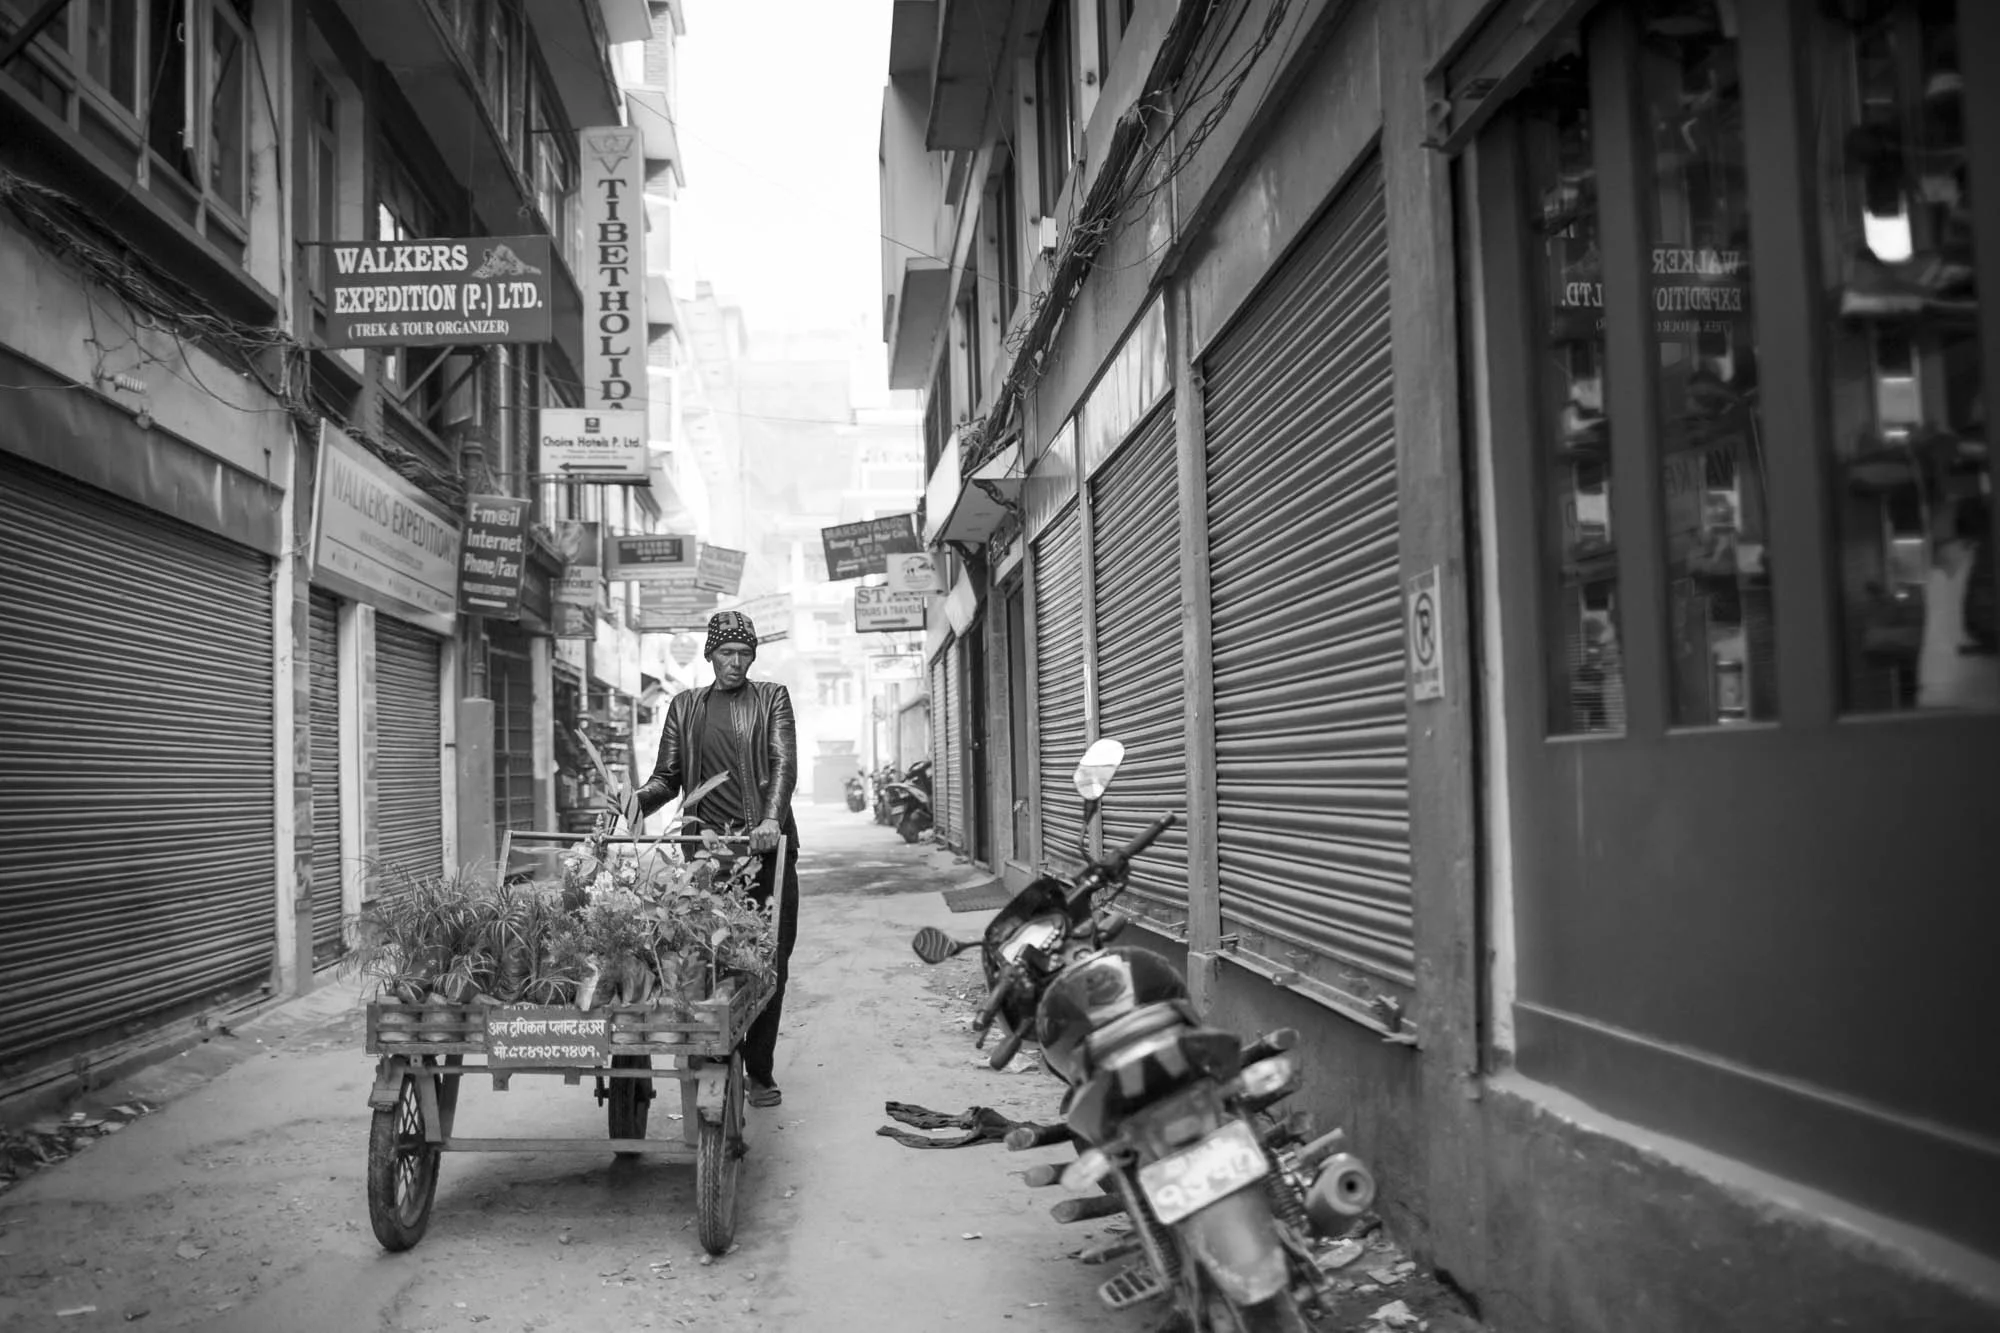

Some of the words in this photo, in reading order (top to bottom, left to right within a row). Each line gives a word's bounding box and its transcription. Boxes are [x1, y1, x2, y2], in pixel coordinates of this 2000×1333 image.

[598, 179, 628, 286] TIBET
[334, 244, 468, 273] WALKERS
[334, 284, 456, 313] EXPEDITION
[463, 283, 492, 317] (P.)
[498, 282, 543, 310] LTD.
[389, 323, 399, 335] &
[402, 321, 434, 335] TOUR
[435, 319, 509, 336] ORGANIZER)
[600, 291, 632, 410] HOLID
[624, 437, 643, 447] Ltd.
[332, 456, 389, 526] WALKERS
[469, 502, 521, 527] E-m@il
[467, 528, 522, 552] Internet
[463, 552, 519, 578] Phone/Fax
